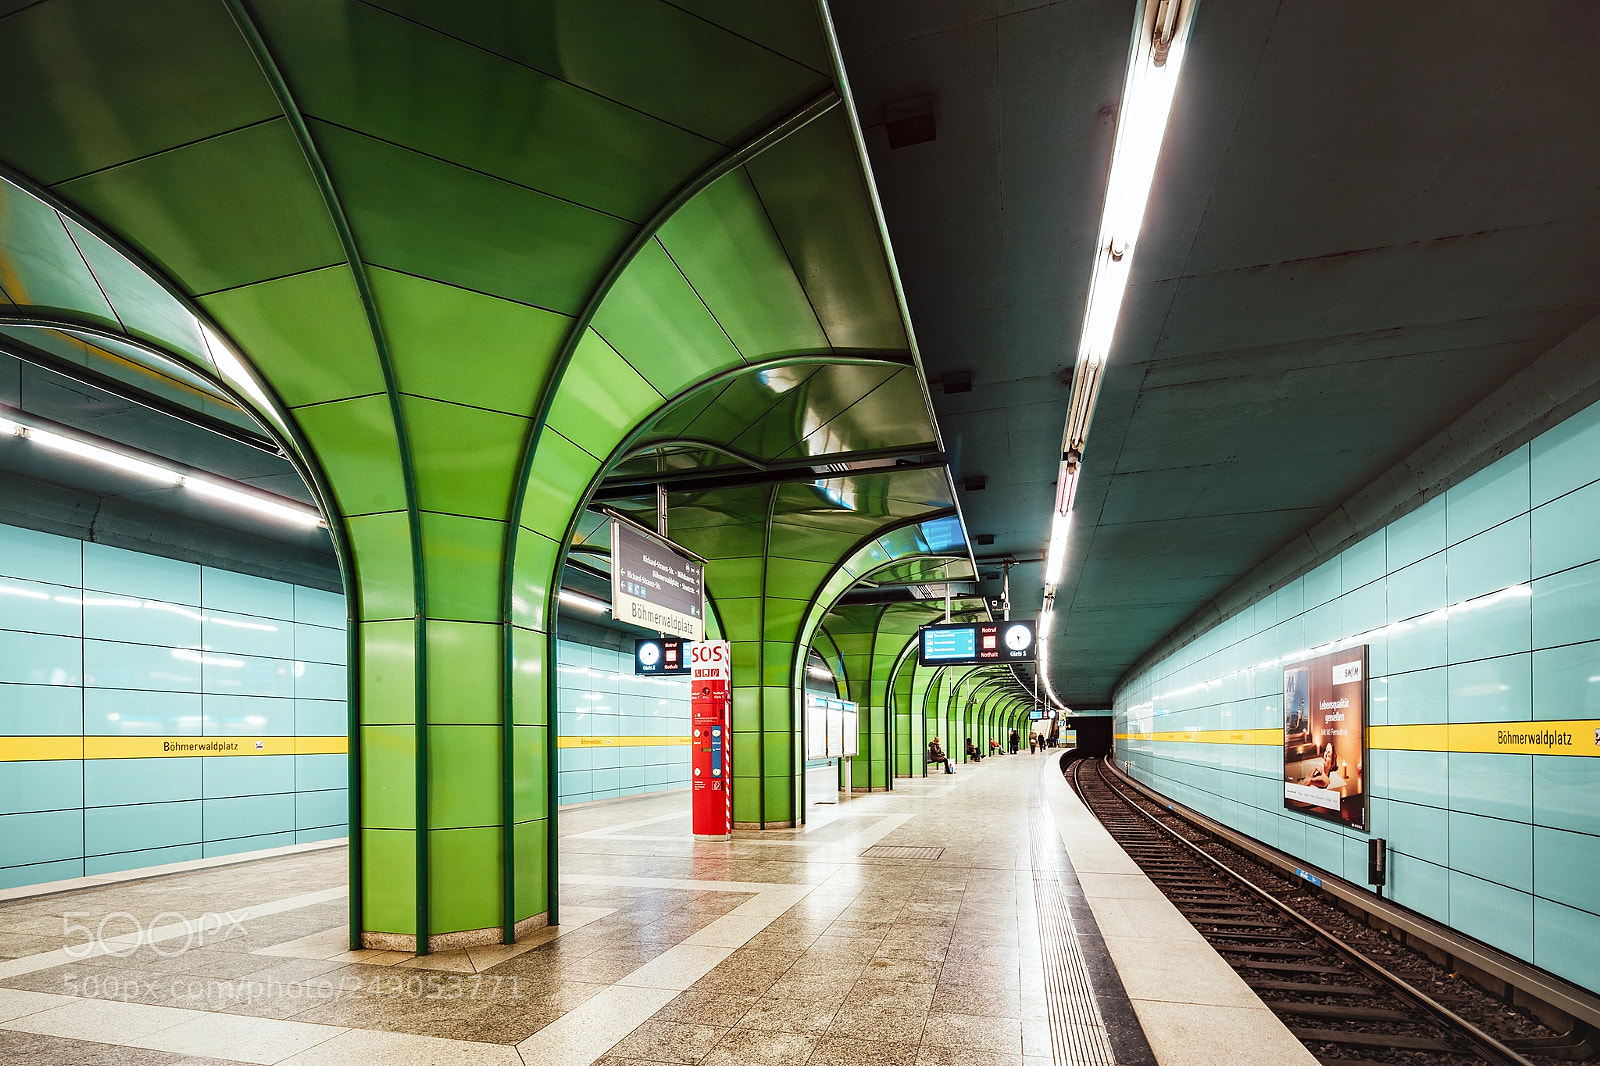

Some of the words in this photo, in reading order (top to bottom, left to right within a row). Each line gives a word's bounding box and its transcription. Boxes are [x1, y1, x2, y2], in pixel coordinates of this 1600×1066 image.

[631, 601, 694, 635] Böhmerwaldplatz
[691, 645, 723, 663] SOS
[1319, 698, 1350, 711] Lebensqualität
[1324, 711, 1345, 725] genießen
[163, 741, 239, 753] Böhmerwaldplatz
[1497, 730, 1572, 749] Böhmerwaldplatz
